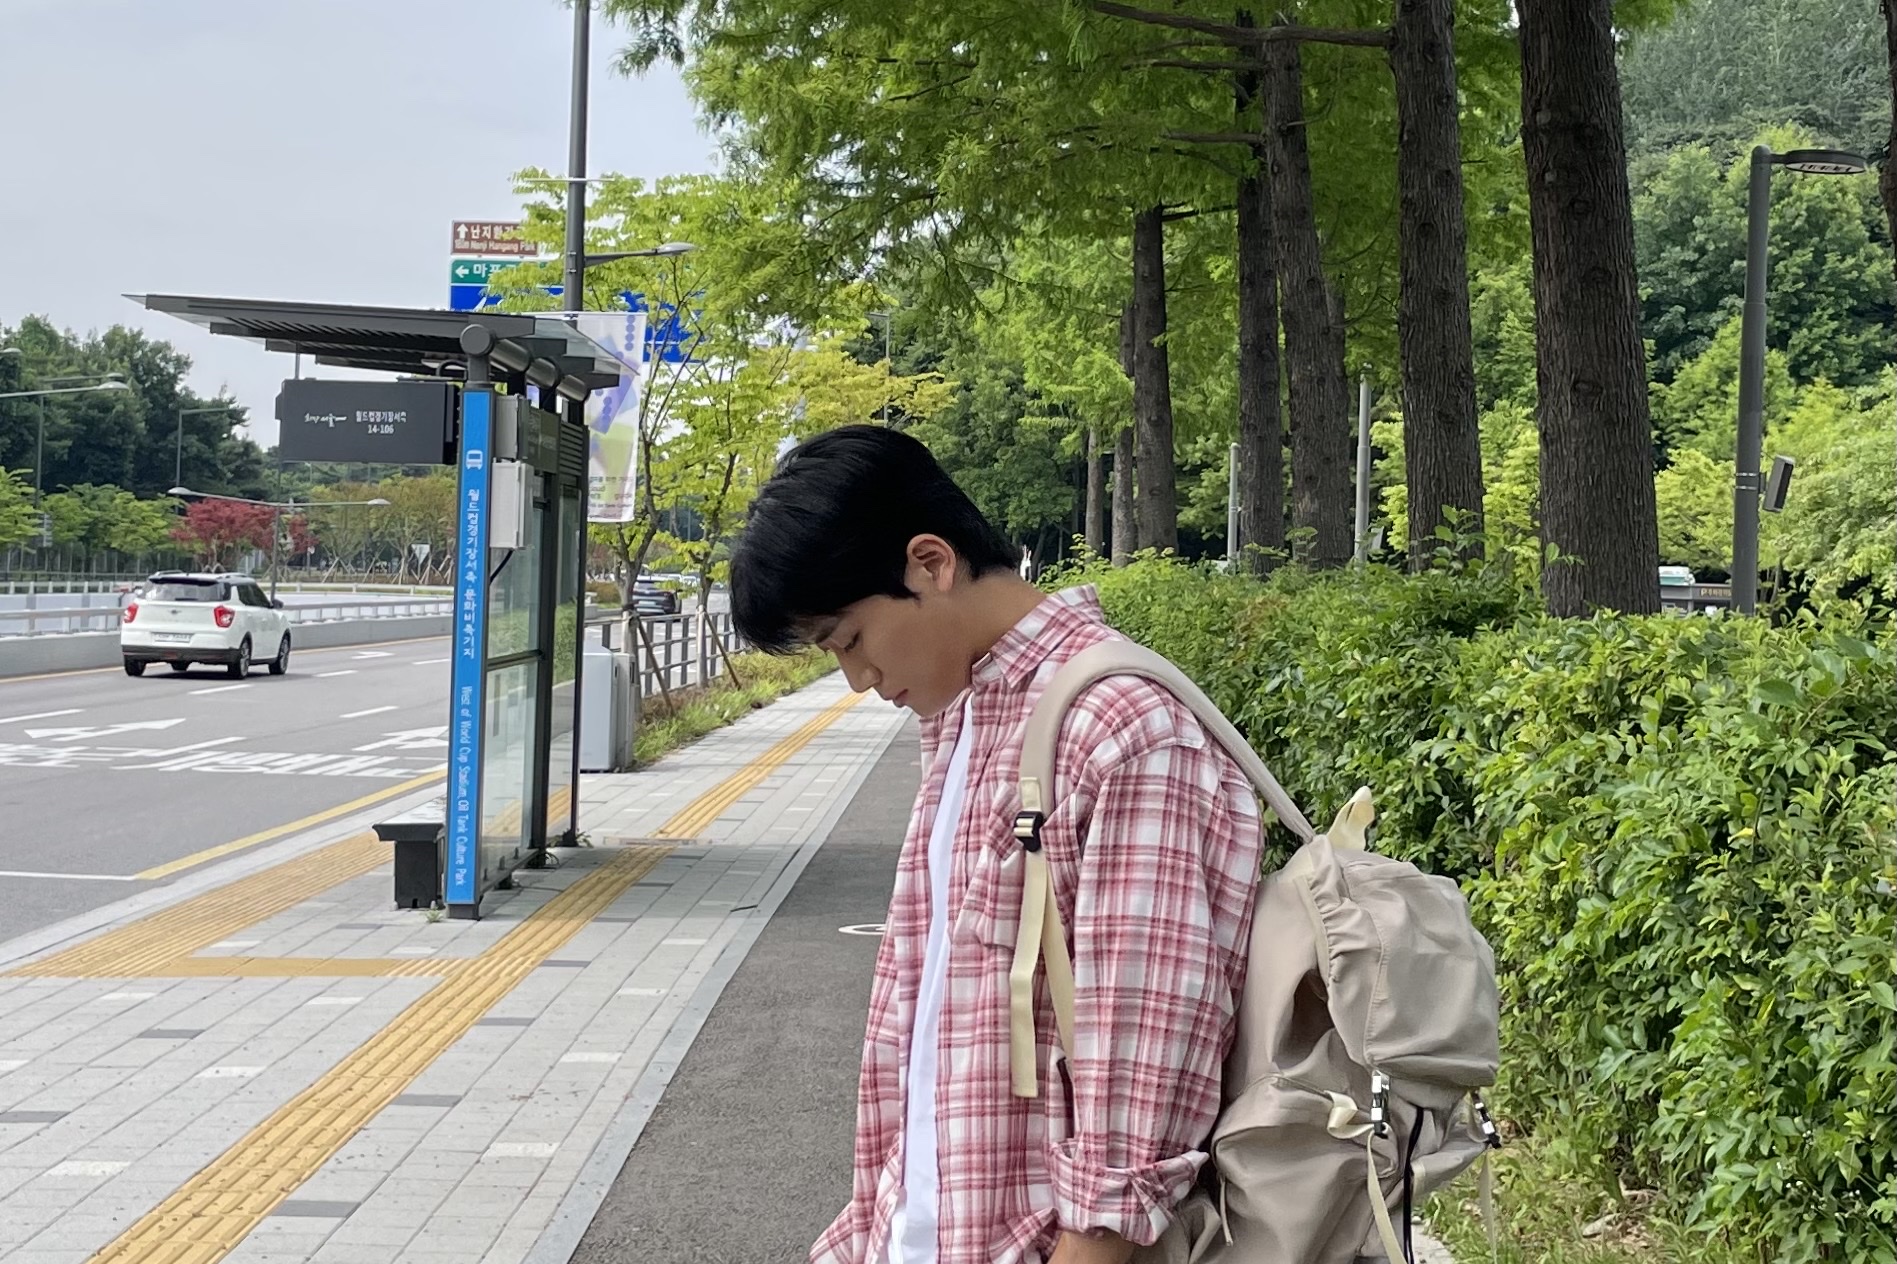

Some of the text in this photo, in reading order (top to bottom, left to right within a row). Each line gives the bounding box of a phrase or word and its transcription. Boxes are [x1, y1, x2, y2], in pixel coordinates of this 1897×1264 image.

[460, 686, 473, 705] West
[460, 708, 472, 718] of
[459, 720, 472, 744] World
[457, 747, 472, 764] Cup
[457, 814, 469, 833] Tank
[455, 836, 468, 865] Culture
[455, 868, 467, 886] Park
